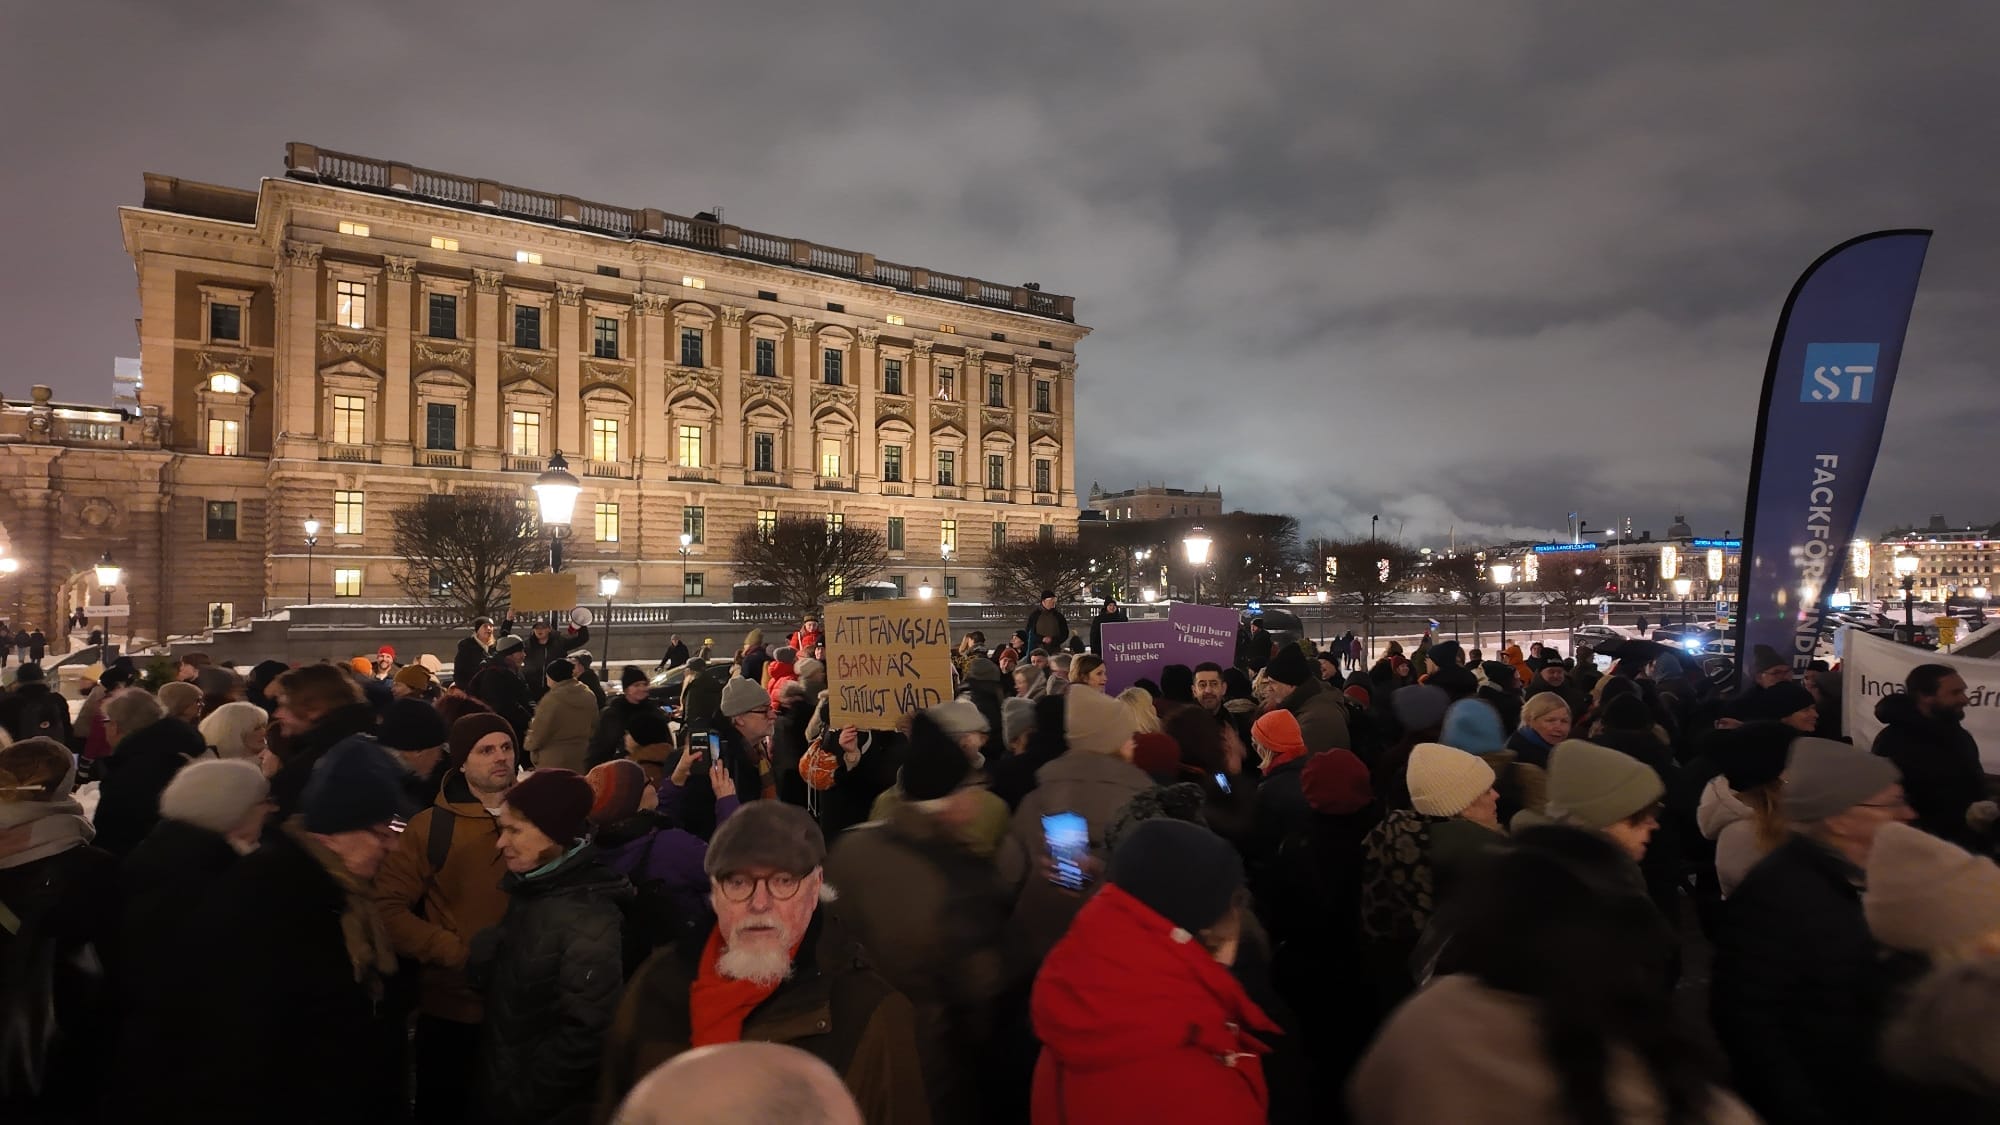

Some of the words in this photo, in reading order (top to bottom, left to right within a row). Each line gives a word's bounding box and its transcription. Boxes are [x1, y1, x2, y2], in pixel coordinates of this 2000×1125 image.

[1811, 366, 1874, 401] ST
[1790, 453, 1839, 686] FACKFÖRUNDET
[1719, 601, 1728, 611] P
[834, 616, 865, 645] ATT
[868, 615, 948, 649] FÄNGSLA
[1173, 622, 1191, 633] Nej
[1192, 624, 1207, 634] till
[1208, 626, 1232, 638] barn
[1183, 634, 1225, 648] fängelse
[1108, 643, 1125, 653] Nej
[1127, 641, 1141, 651] till
[1142, 641, 1165, 650] barn
[1120, 652, 1160, 663] fängelse
[838, 653, 882, 680] BARN
[886, 651, 921, 679] ÄR
[894, 683, 941, 714] VÅLD
